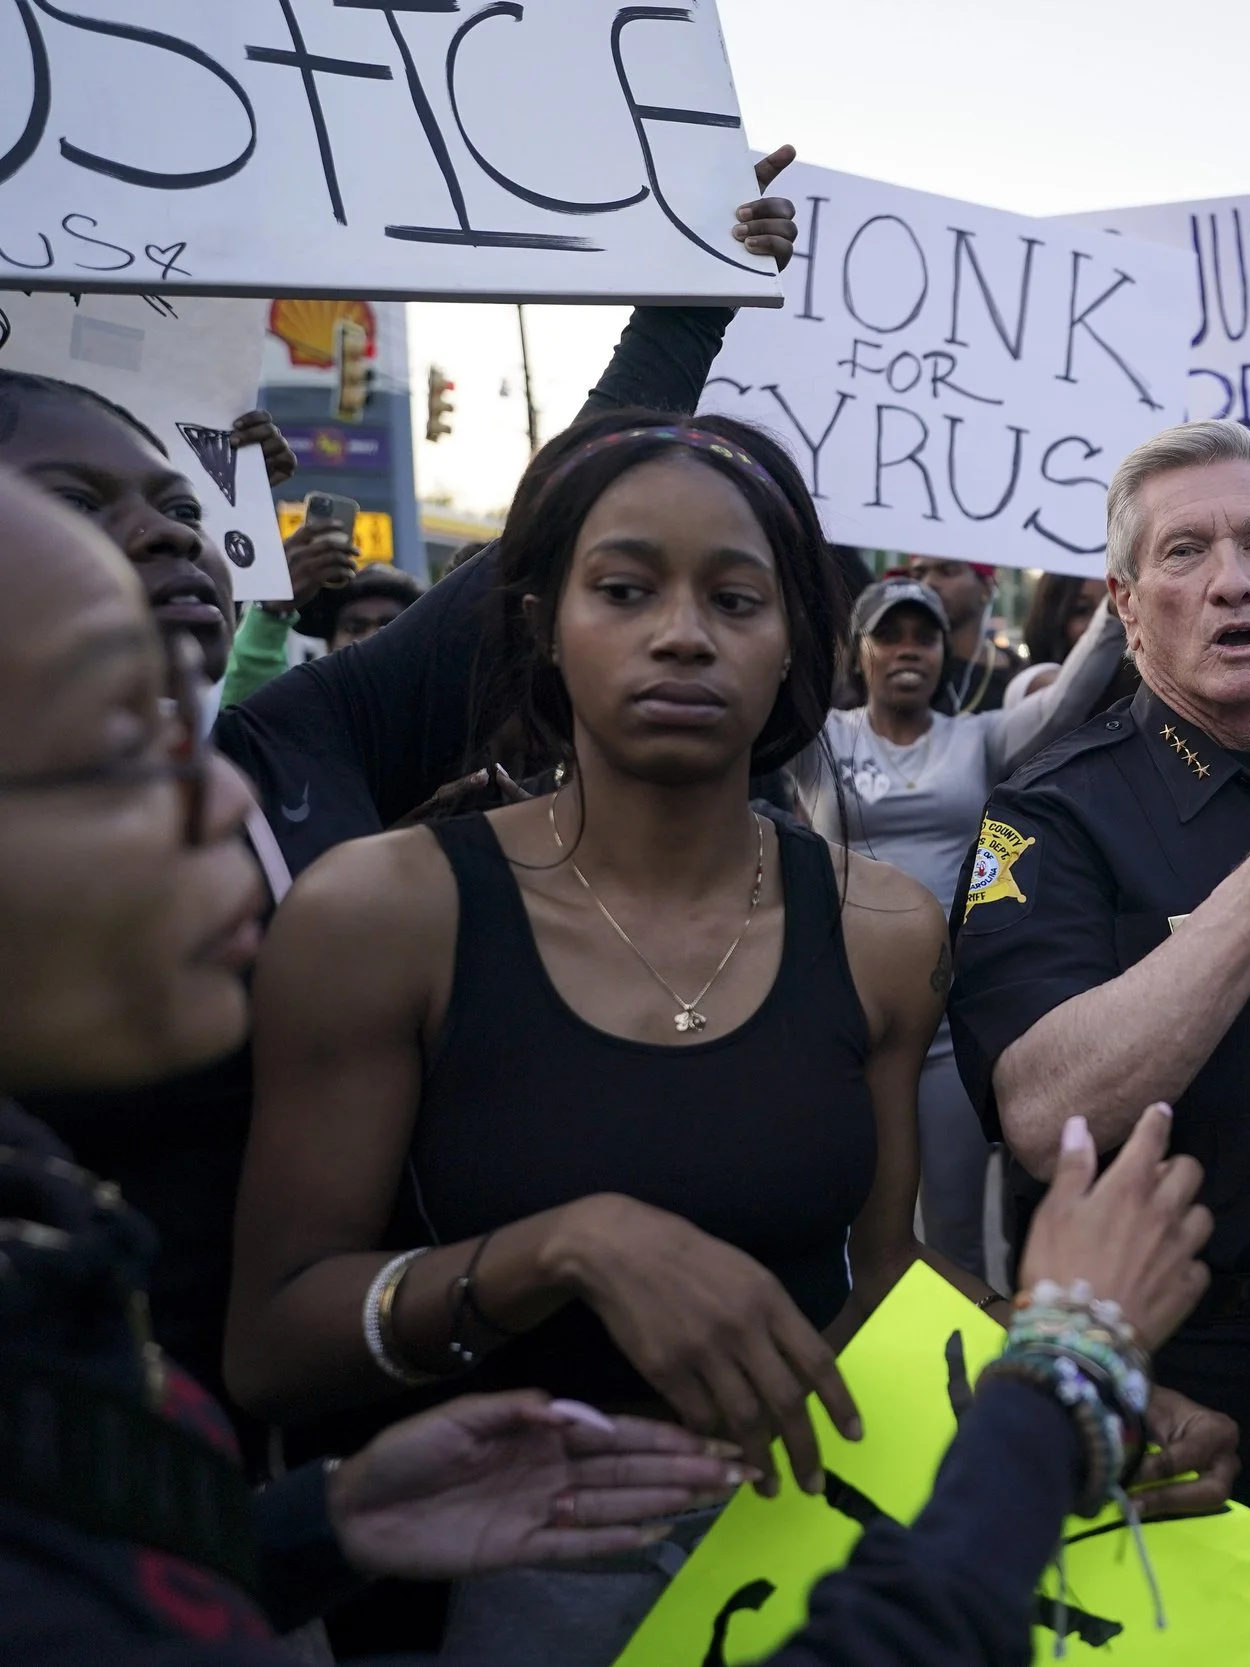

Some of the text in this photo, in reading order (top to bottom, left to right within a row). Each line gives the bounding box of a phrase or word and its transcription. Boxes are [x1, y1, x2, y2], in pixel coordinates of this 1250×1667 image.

[837, 338, 1004, 406] FOR
[704, 376, 1109, 556] YRUS
[988, 822, 1023, 848] COUNTY
[969, 866, 998, 891] AROLINA
[966, 891, 987, 903] RIFF
